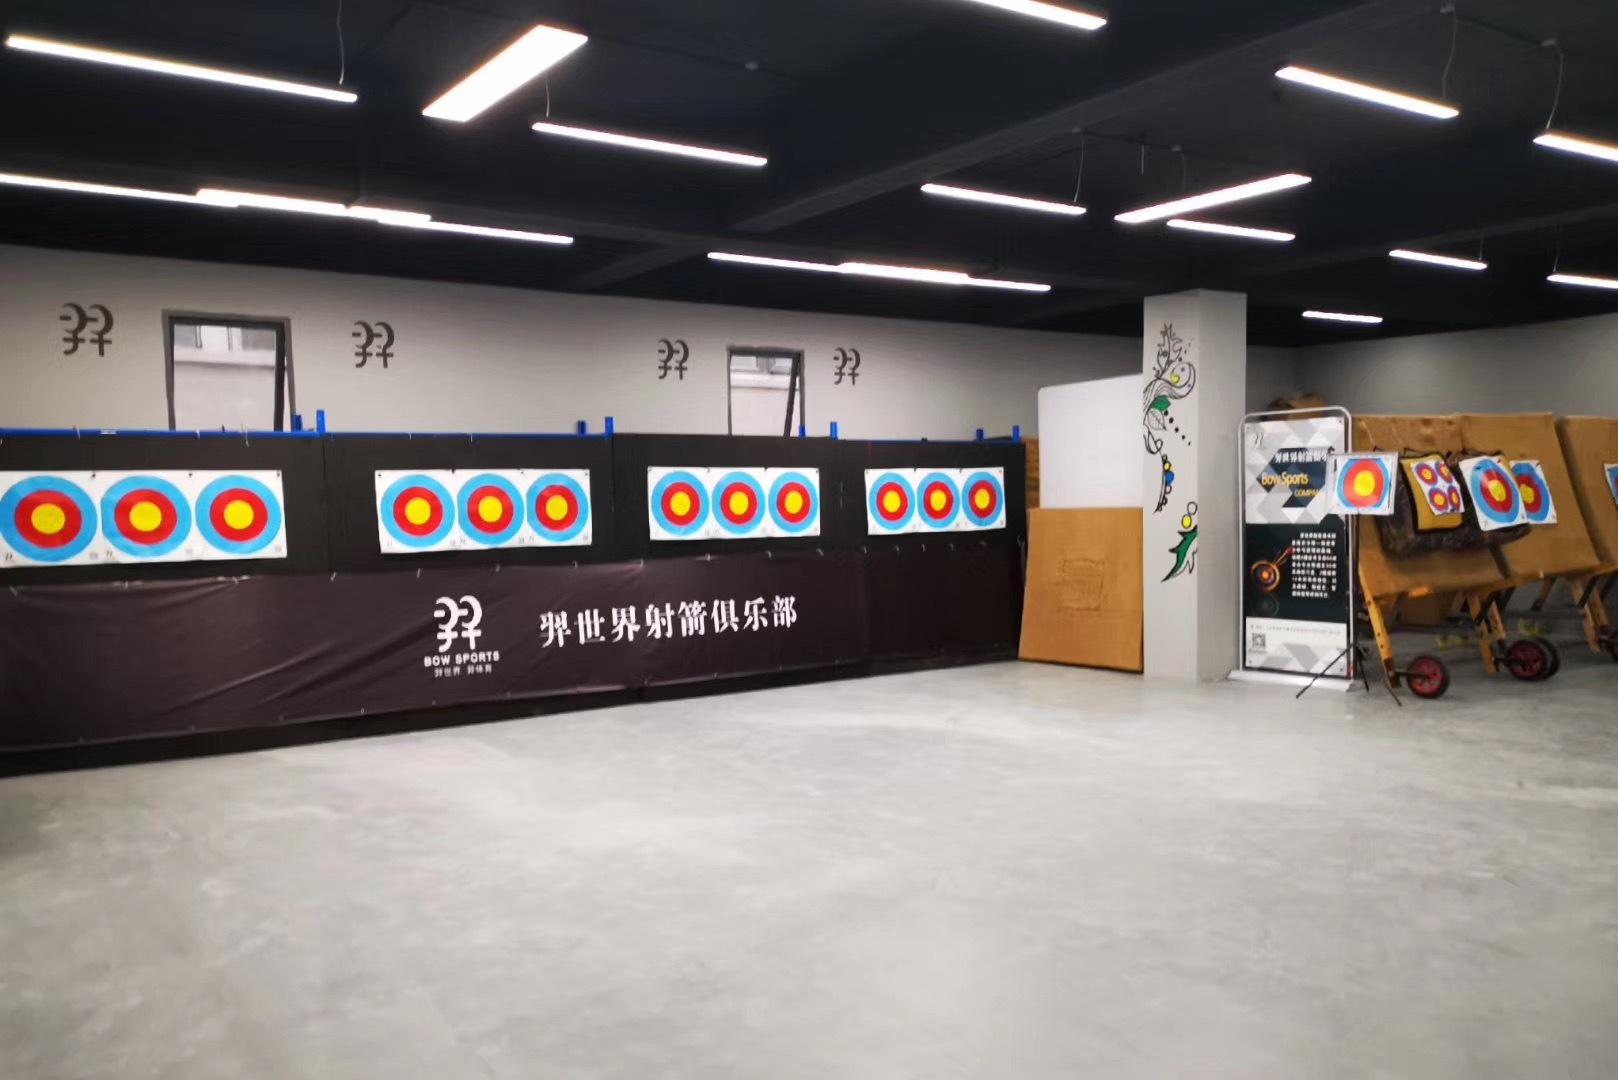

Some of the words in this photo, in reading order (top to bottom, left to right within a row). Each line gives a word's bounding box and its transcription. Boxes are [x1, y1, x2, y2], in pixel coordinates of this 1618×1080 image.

[1281, 471, 1309, 487] Sports
[424, 654, 451, 667] BOW
[455, 650, 500, 665] SPORTS
